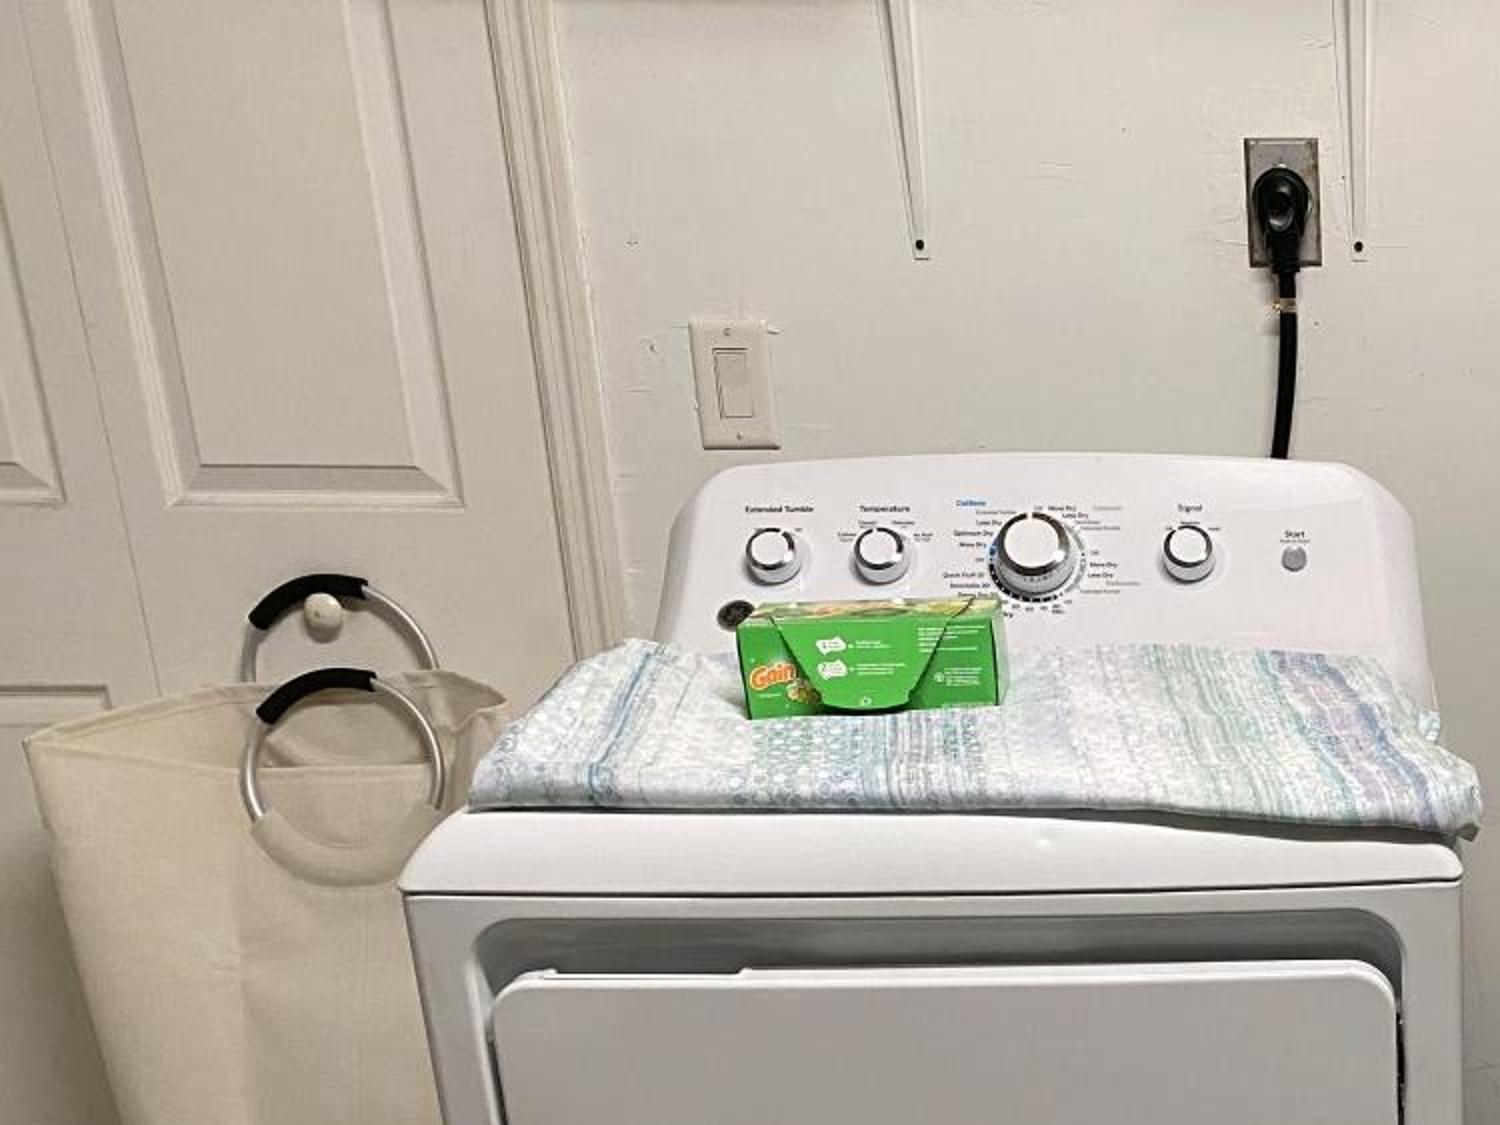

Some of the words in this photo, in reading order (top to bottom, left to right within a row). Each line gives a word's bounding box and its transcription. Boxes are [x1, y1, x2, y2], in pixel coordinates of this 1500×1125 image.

[859, 504, 911, 513] Temperature
[1177, 503, 1203, 513] Signal
[1284, 530, 1305, 539] Start
[750, 661, 797, 690] Gain
